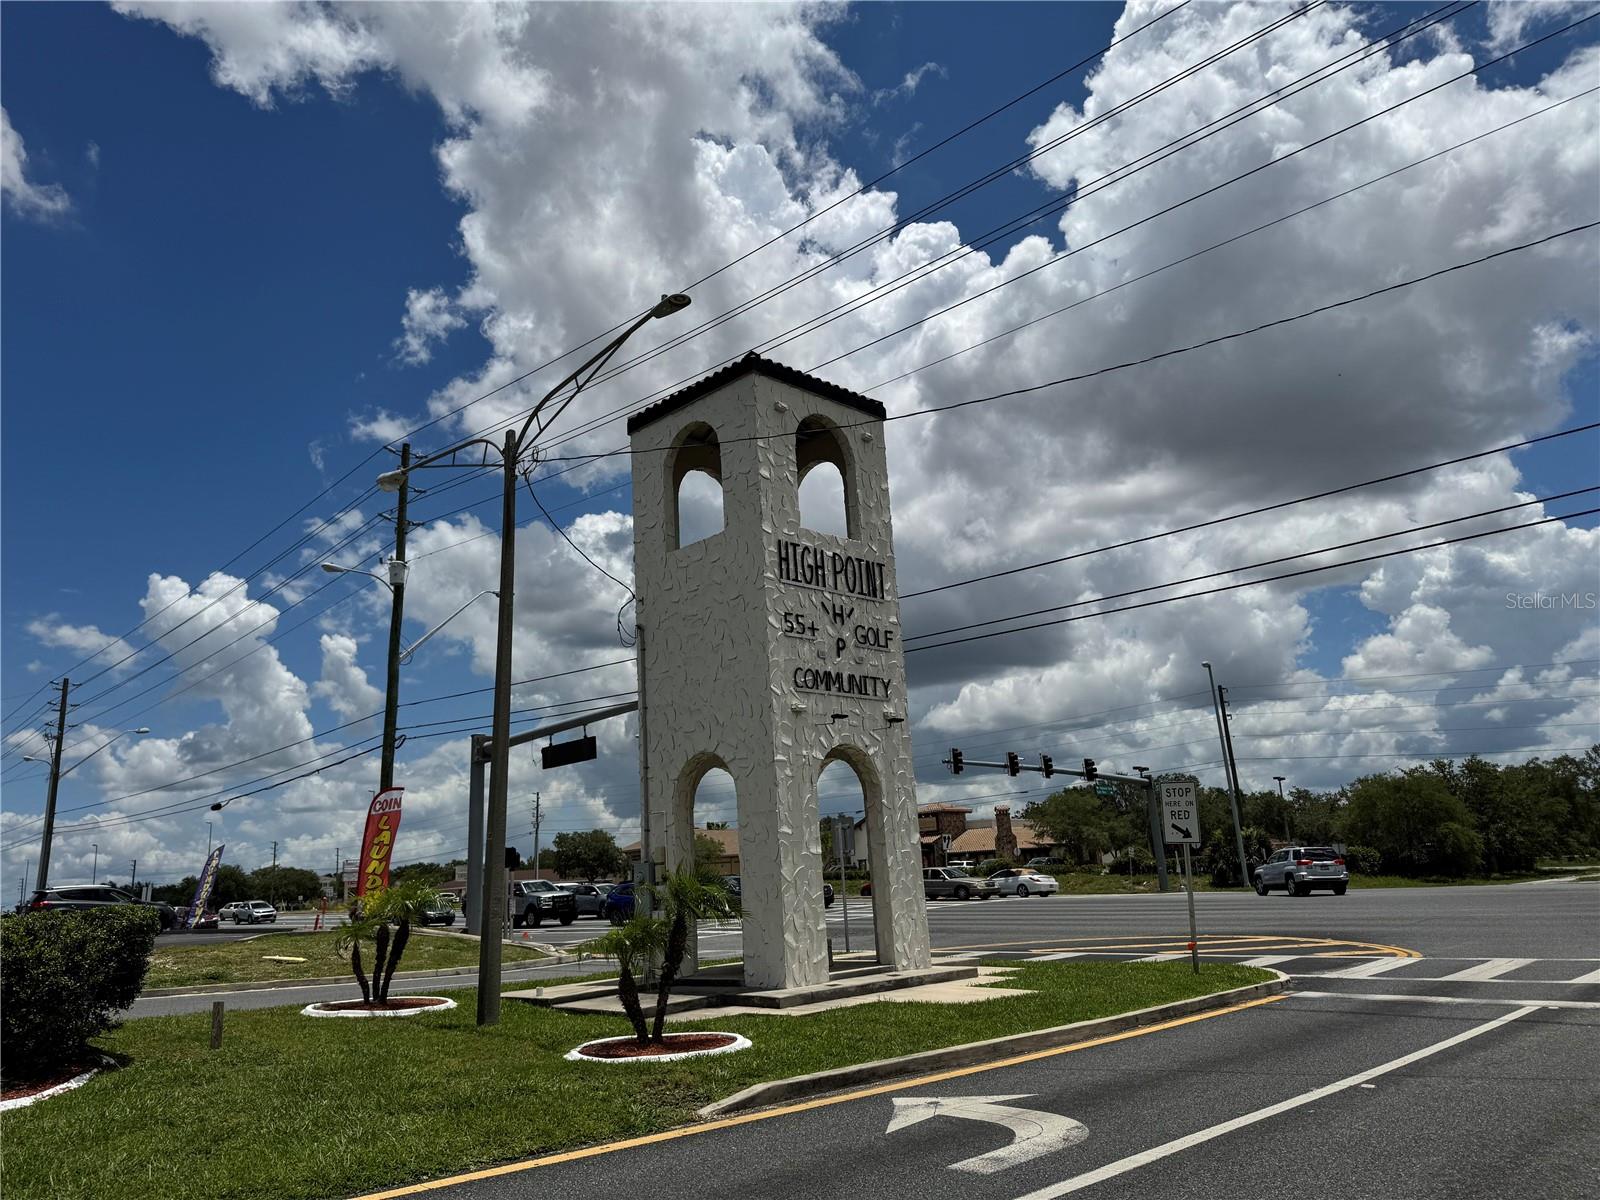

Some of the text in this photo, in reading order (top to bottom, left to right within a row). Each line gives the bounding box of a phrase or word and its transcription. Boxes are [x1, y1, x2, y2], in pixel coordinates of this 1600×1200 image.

[778, 539, 886, 600] HIGH POINT
[784, 611, 820, 637] 55+
[854, 624, 894, 649] GOLF
[836, 637, 847, 658] P
[793, 667, 892, 698] COMMUNITY
[1165, 787, 1191, 797] STOP
[373, 798, 401, 812] COIN
[1170, 810, 1190, 820] RED
[365, 815, 392, 893] LAUND
